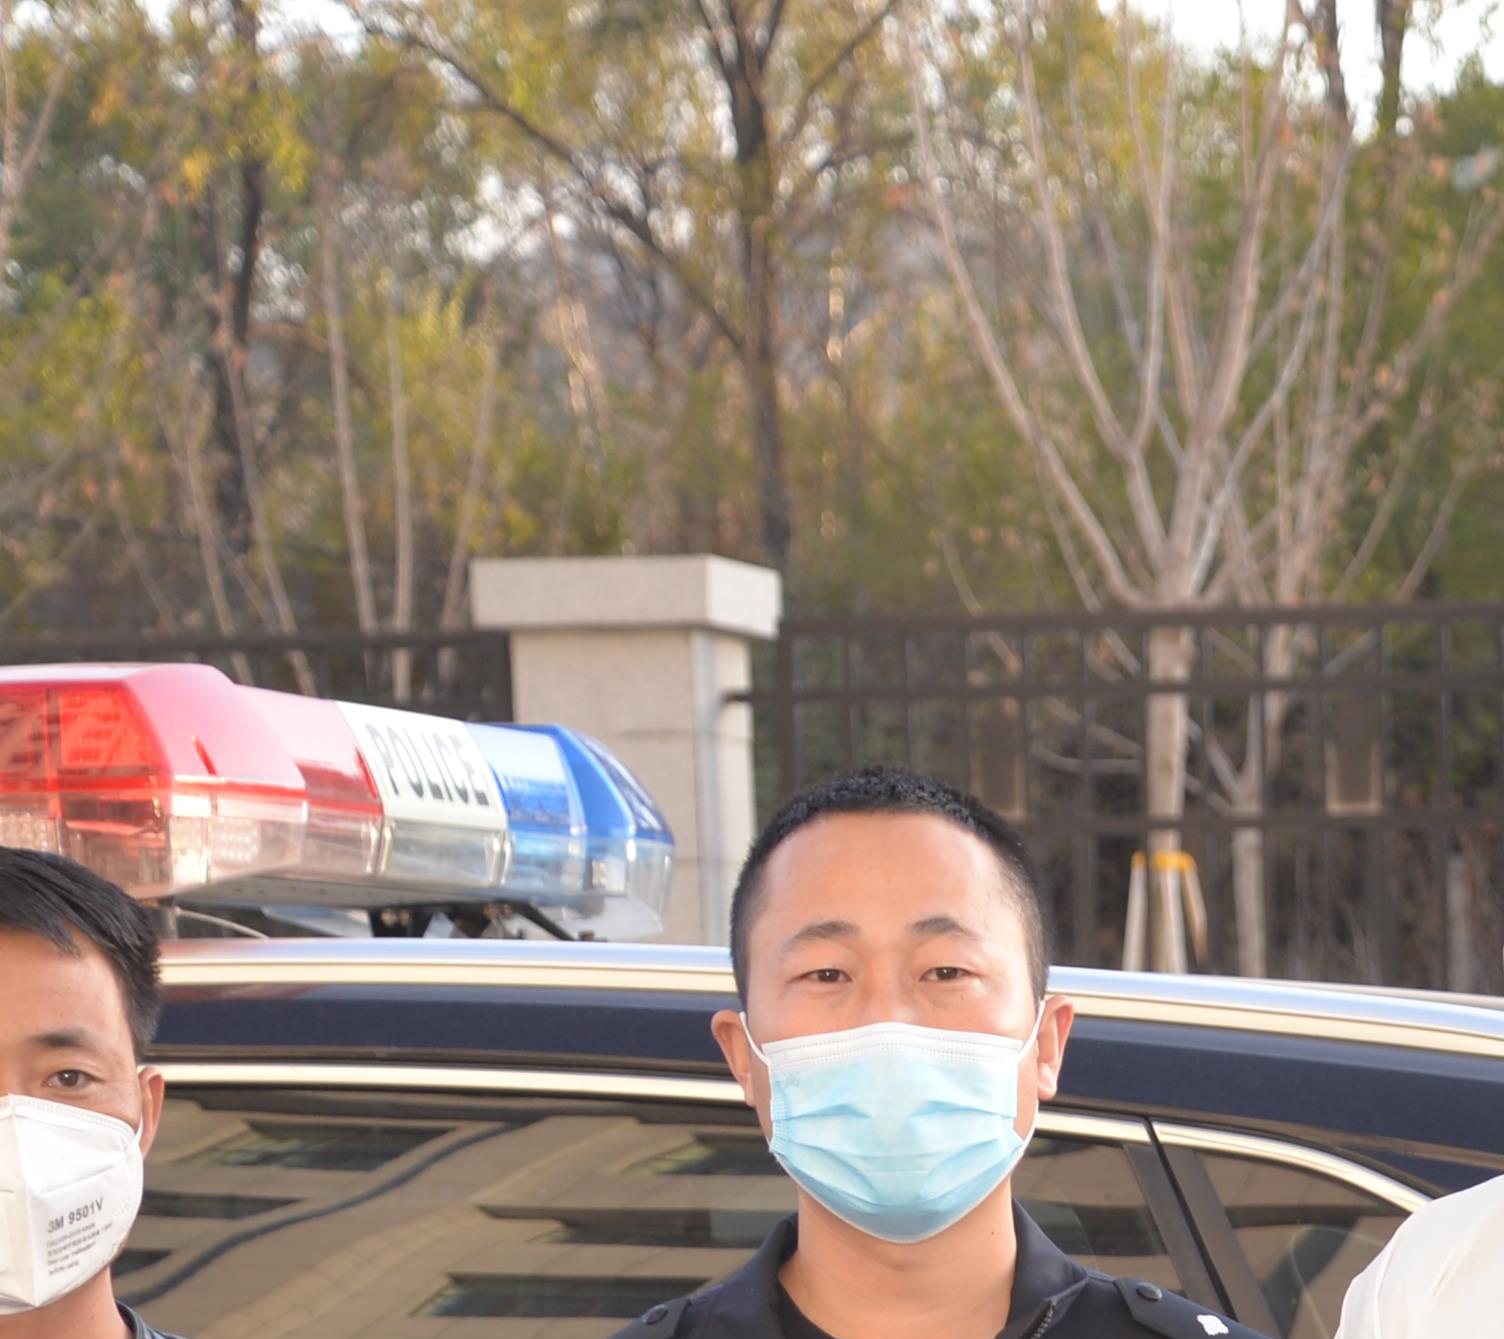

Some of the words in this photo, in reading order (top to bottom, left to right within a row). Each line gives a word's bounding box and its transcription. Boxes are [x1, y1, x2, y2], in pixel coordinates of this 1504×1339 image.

[363, 722, 490, 806] POLICE
[47, 1215, 64, 1233] 3M
[68, 1196, 104, 1225] 9501V
